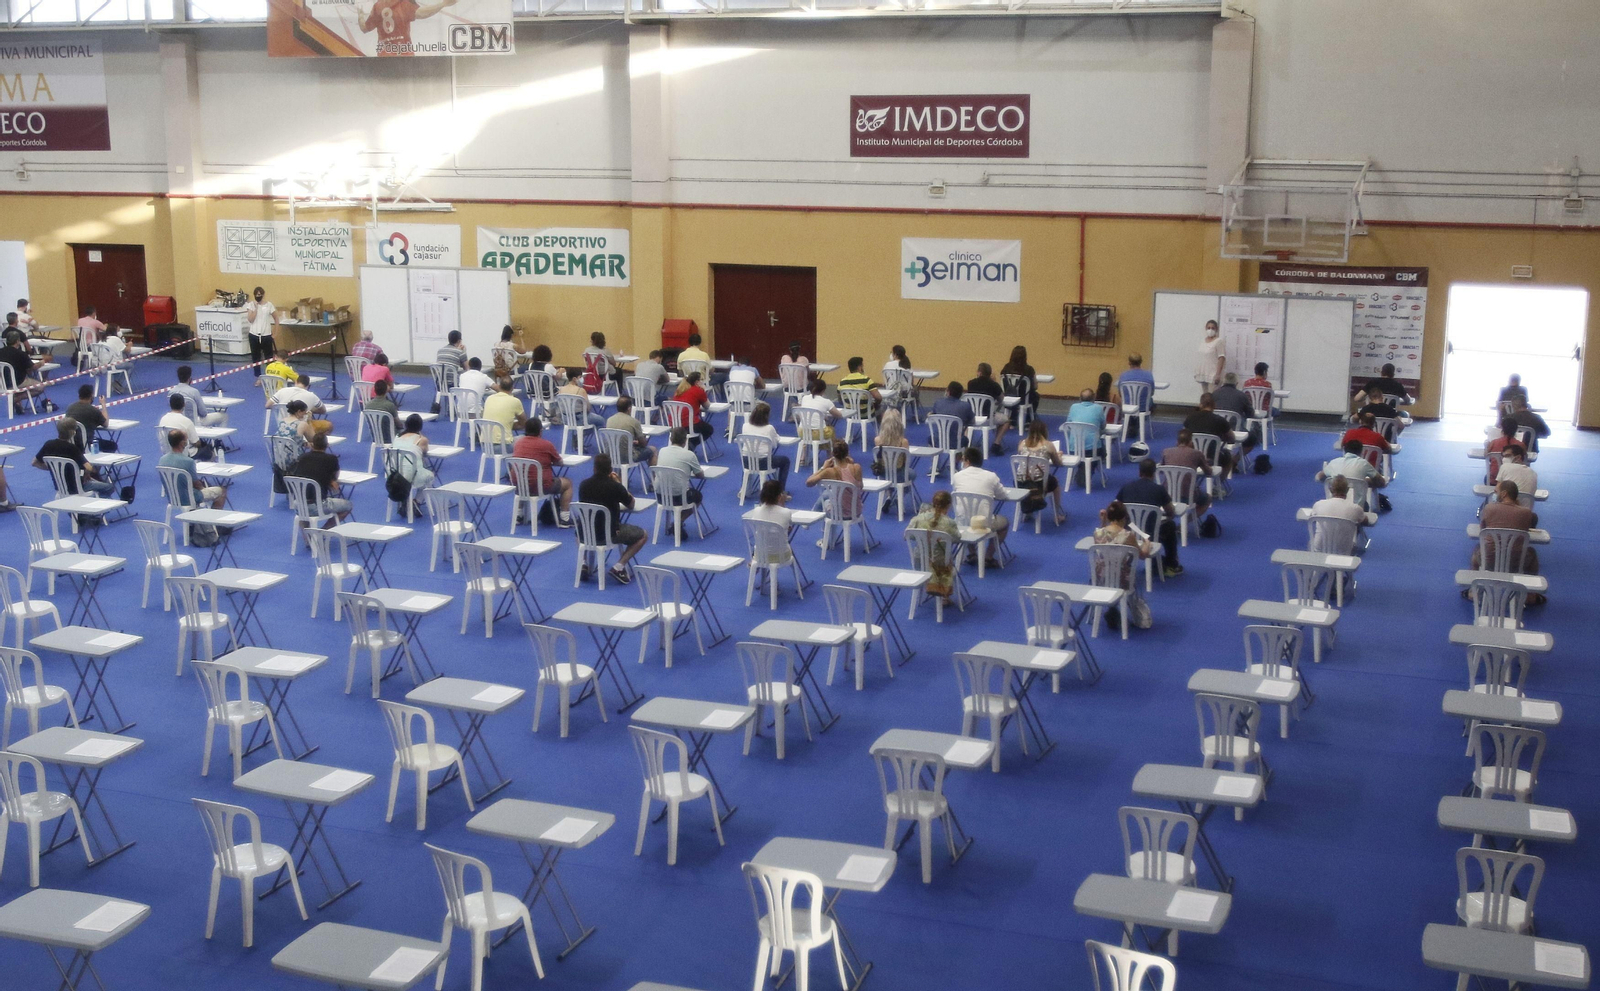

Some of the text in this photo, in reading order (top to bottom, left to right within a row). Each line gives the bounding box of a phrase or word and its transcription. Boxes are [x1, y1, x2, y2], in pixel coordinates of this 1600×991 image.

[381, 7, 395, 34] 8
[452, 26, 508, 50] CBM
[25, 45, 93, 59] MUNICIPAL
[376, 42, 447, 54] #dejatuhuella
[894, 105, 1025, 132] IMDECO
[856, 138, 1023, 147] Instituto Municipal de Deportes Córdoba
[291, 238, 347, 248] DEPORTIVA
[413, 244, 450, 252] fundación
[499, 235, 607, 249] CLUB DEPORTIVO
[294, 249, 344, 260] MUNICIPAL
[413, 252, 442, 260] cajasur
[303, 260, 337, 272] FÁTIMA
[481, 252, 627, 280] APADEMAR
[916, 256, 1018, 288] Beiman
[1275, 268, 1315, 278] CÓRDOBA
[1330, 271, 1386, 280] BALONMANO
[1395, 272, 1418, 281] CBM
[198, 321, 232, 332] efficold
